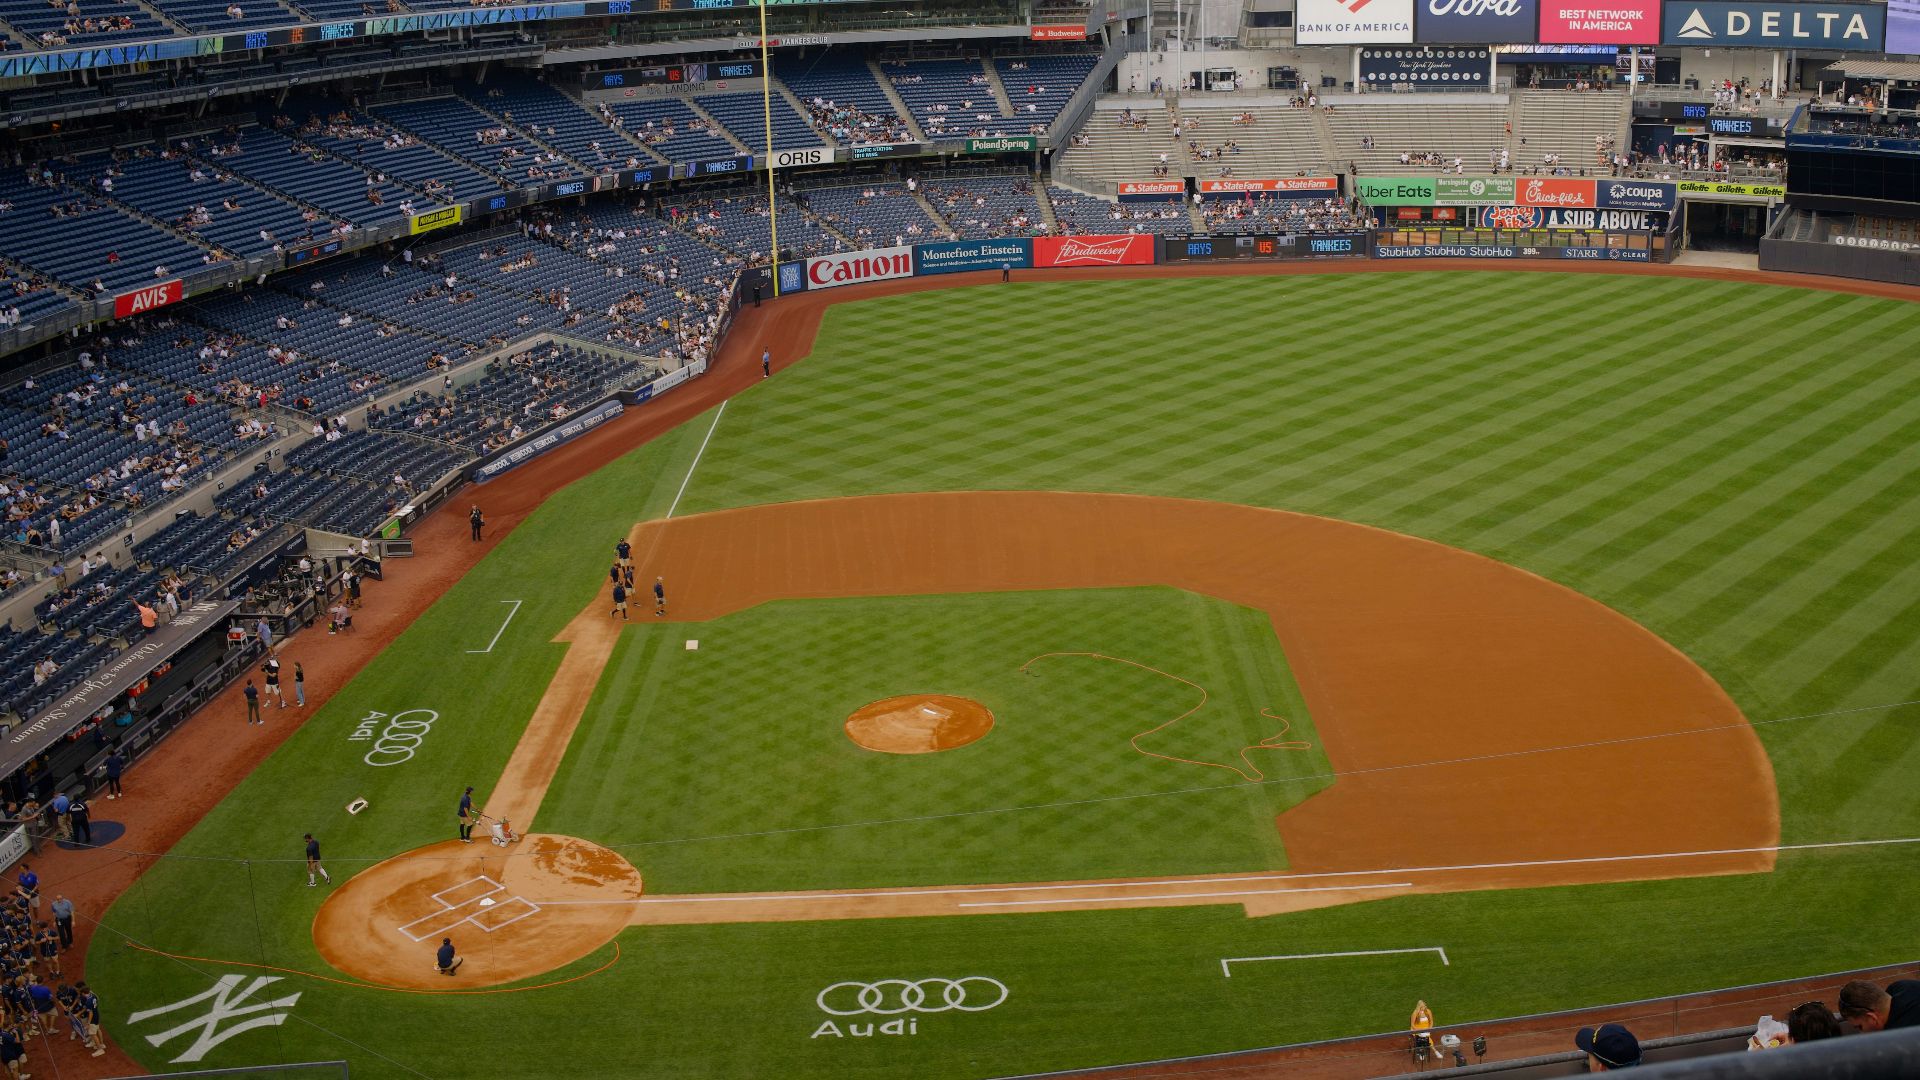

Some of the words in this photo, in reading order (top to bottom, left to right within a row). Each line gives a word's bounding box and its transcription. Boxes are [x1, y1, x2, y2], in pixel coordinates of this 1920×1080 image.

[1560, 10, 1586, 18] BEST
[1588, 10, 1643, 19] NETWORK
[1299, 24, 1332, 32] BANK
[1336, 24, 1350, 32] OF
[1354, 23, 1409, 31] AMERICA
[1569, 21, 1580, 30] IN
[1582, 21, 1632, 30] AMERICA
[1727, 11, 1868, 40] DELTA
[246, 32, 268, 48] RAYS
[320, 22, 354, 40] YANKEES
[604, 74, 624, 86] RAYS
[719, 64, 752, 76] YANKEES
[666, 82, 706, 93] LANDING
[1683, 106, 1706, 117] RAYS
[1711, 120, 1752, 132] YANKEES
[973, 140, 1000, 150] Poland
[1001, 139, 1029, 150] Spring
[779, 150, 820, 166] ORIS
[705, 161, 737, 173] YANKEES
[635, 171, 652, 182] RAYS
[556, 182, 584, 195] YANKEES
[1360, 186, 1394, 197] Uber
[1397, 186, 1432, 198] Eats
[1627, 187, 1662, 200] coupa
[1680, 183, 1709, 192] Gillette
[1716, 185, 1746, 194] Gillette
[1753, 187, 1782, 196] Gillette
[1490, 206, 1534, 219] Jersey
[1549, 210, 1557, 225] A
[1564, 210, 1595, 228] SUB
[1599, 211, 1650, 229] ABOVE
[922, 248, 978, 260] Montefiore
[981, 244, 1023, 256] Einstein
[1061, 244, 1125, 256] Budweiser
[1188, 242, 1212, 255] RAYS
[1311, 240, 1352, 251] YANKEES
[1379, 248, 1420, 257] StubHub
[1425, 247, 1466, 256] StubHub
[1470, 247, 1512, 257] StubHub
[1566, 249, 1599, 257] STARR
[809, 254, 910, 284] Canon
[782, 273, 799, 281] YORK
[783, 280, 798, 288] LIFE
[132, 287, 168, 312] AVIS
[111, 642, 164, 674] Welcome
[60, 679, 112, 709] Yankee
[11, 708, 67, 744] Stadium
[347, 711, 388, 741] Audi
[810, 1018, 917, 1038] Audi
